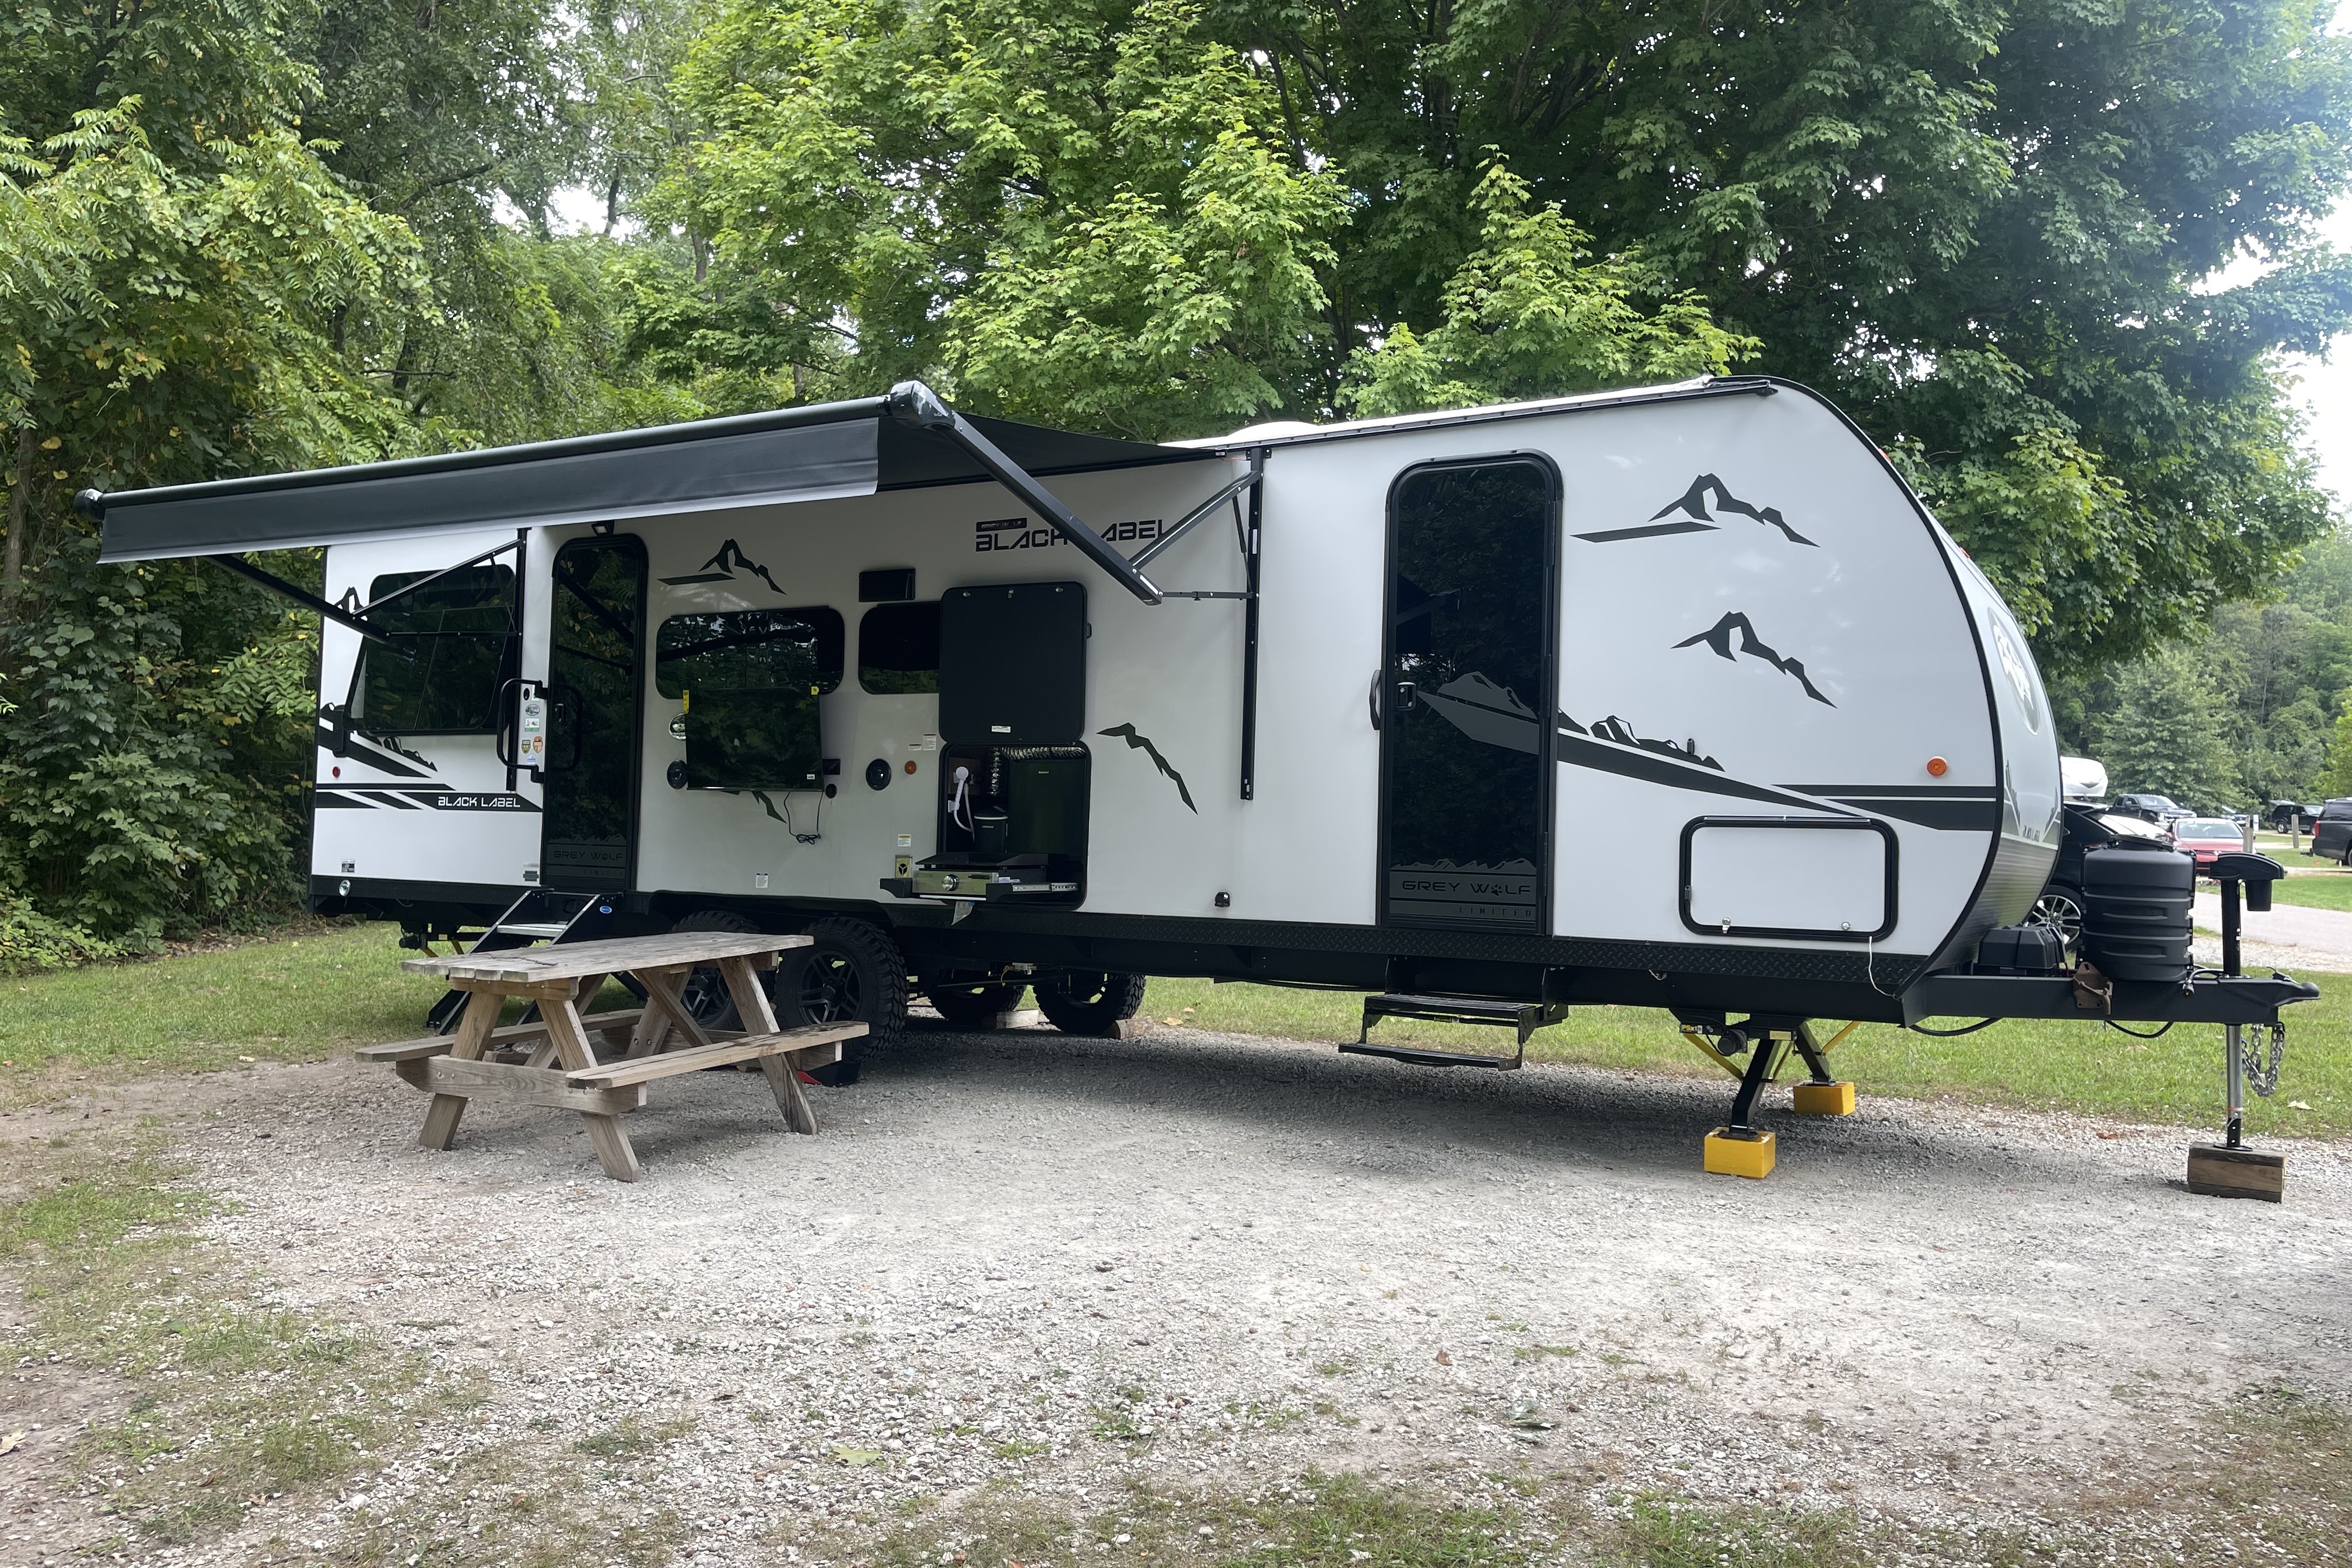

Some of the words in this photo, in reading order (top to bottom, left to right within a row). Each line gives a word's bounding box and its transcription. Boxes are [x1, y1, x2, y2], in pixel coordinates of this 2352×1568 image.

[976, 528, 1068, 552] BLACK
[1093, 519, 1166, 542] ABEL
[438, 796, 477, 807] BLACK
[481, 797, 521, 807] LABEL
[554, 850, 586, 859] GREY
[590, 852, 624, 861] WLF
[1402, 881, 1461, 892] GREY
[1470, 883, 1531, 895] WLF
[1460, 907, 1531, 917] LIMITED
